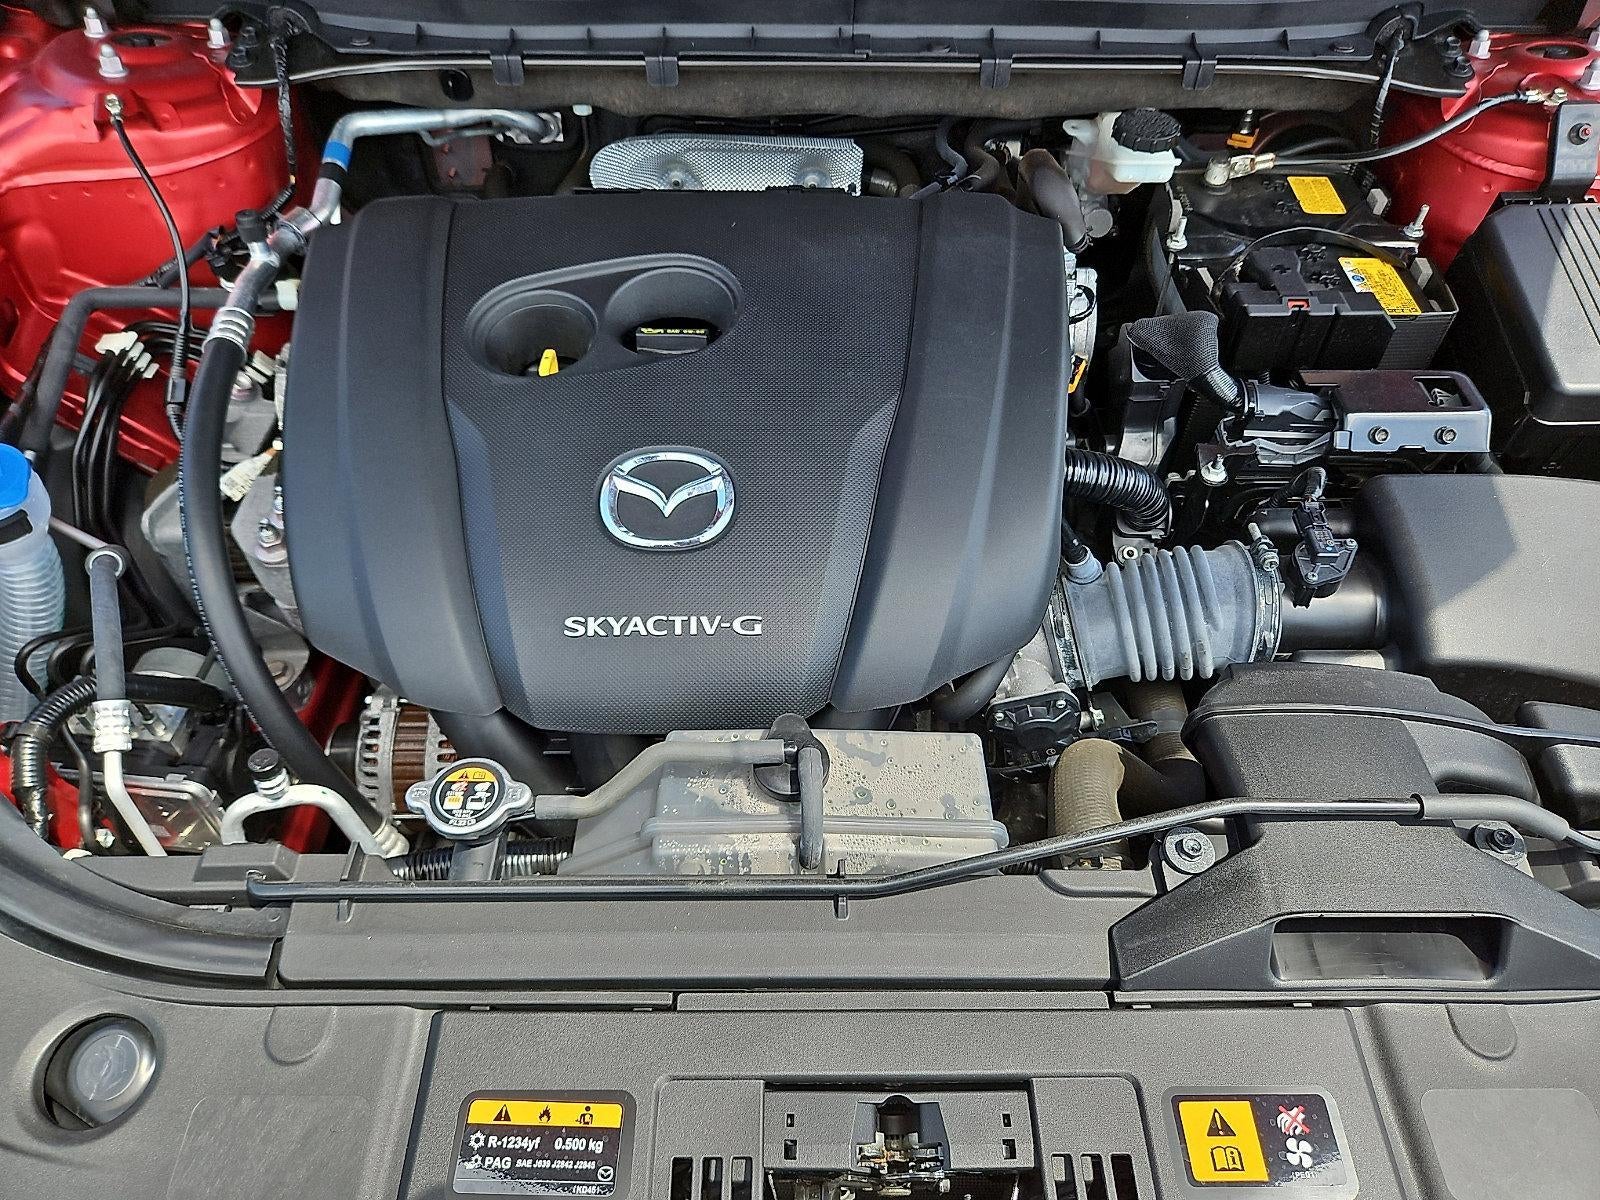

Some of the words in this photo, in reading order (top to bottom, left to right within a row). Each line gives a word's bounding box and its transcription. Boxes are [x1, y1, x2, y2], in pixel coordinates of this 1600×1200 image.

[563, 615, 763, 637] SKYACTIV-G
[487, 1135, 541, 1151] R-1234yf
[554, 1137, 586, 1151] 0.500
[588, 1138, 604, 1153] kg
[484, 1156, 512, 1169] PAG
